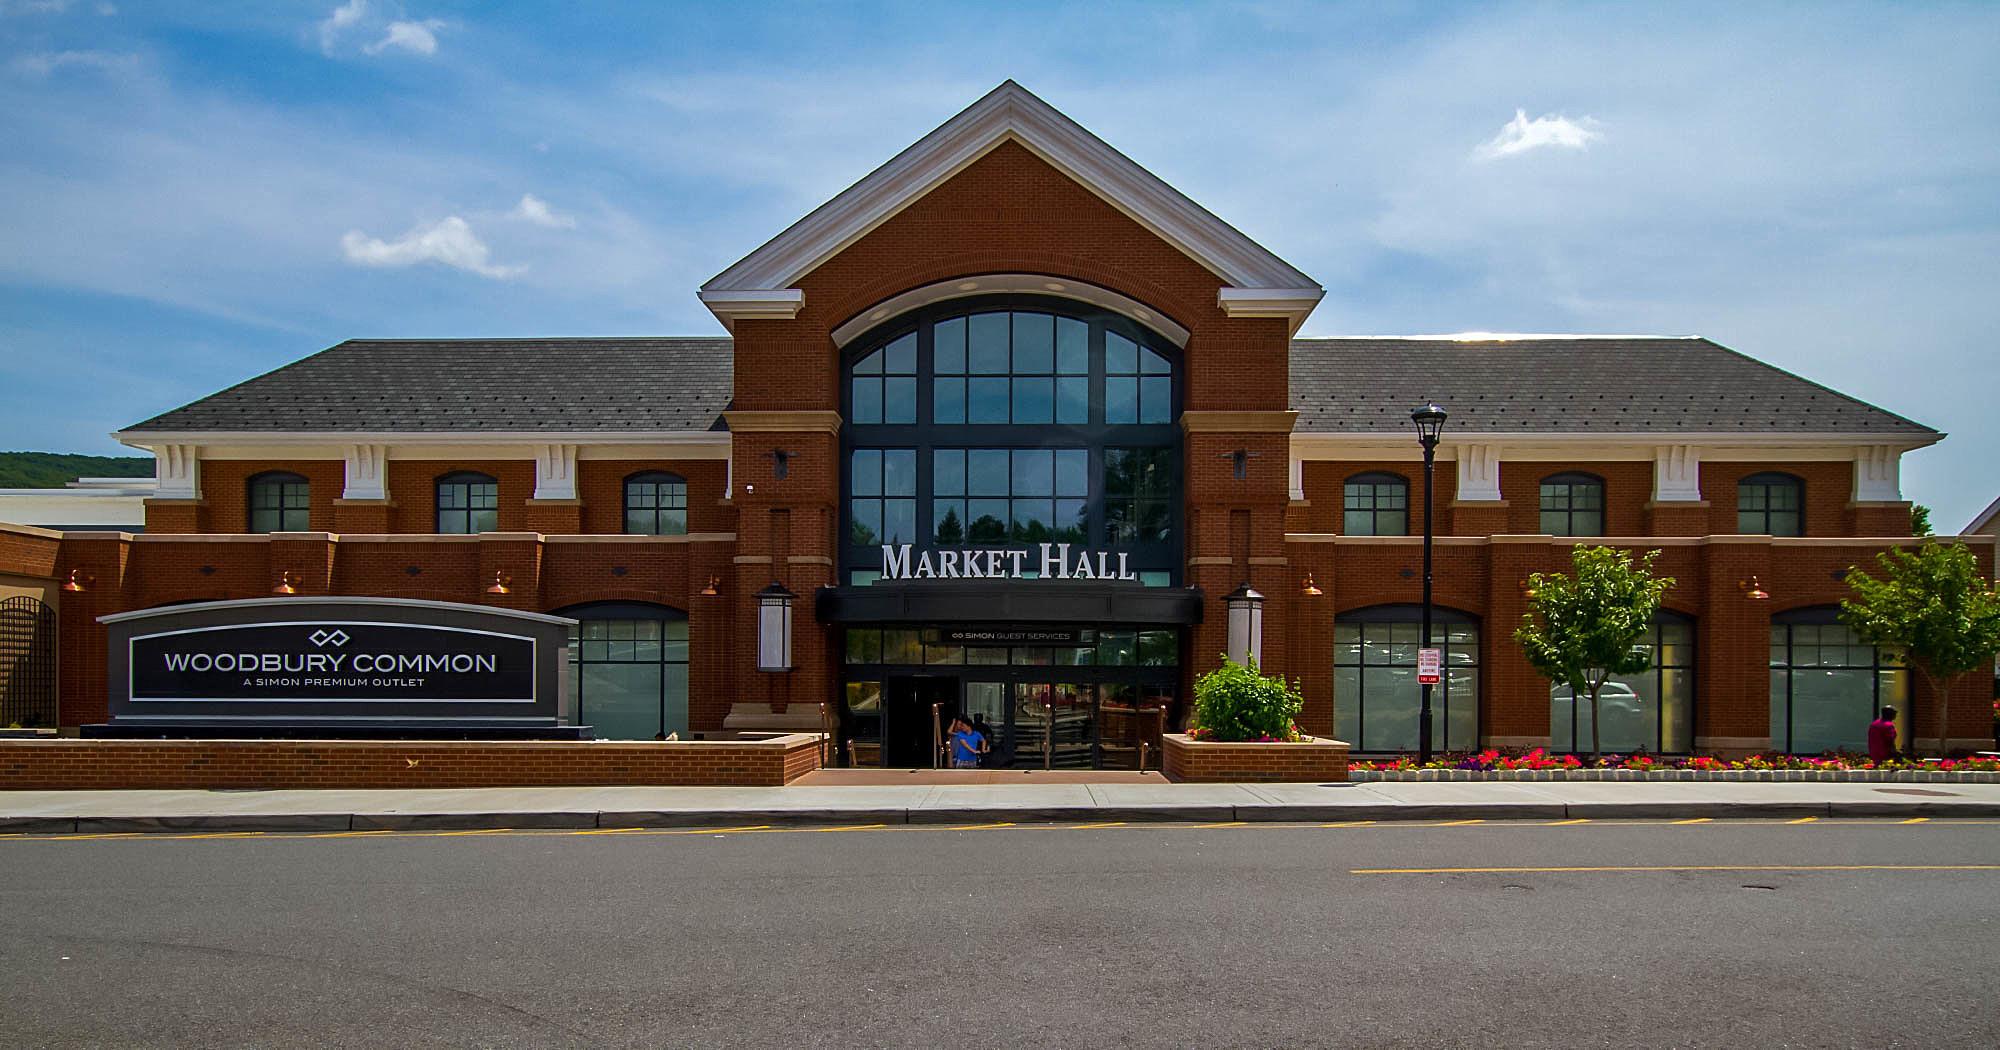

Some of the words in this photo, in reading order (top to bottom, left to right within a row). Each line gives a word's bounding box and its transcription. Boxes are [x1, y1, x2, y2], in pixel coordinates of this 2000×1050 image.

[881, 544, 1027, 580] MARKET
[1039, 543, 1135, 581] HALL
[965, 632, 995, 640] SIMON
[996, 632, 1026, 640] GUEST
[1027, 632, 1071, 640] SERVICES
[164, 653, 347, 672] WOODBURY
[353, 653, 496, 673] COMMON
[243, 678, 252, 686] A
[256, 678, 300, 687] SIMON
[304, 678, 368, 687] PREMIUM
[372, 678, 425, 687] OUTLET
